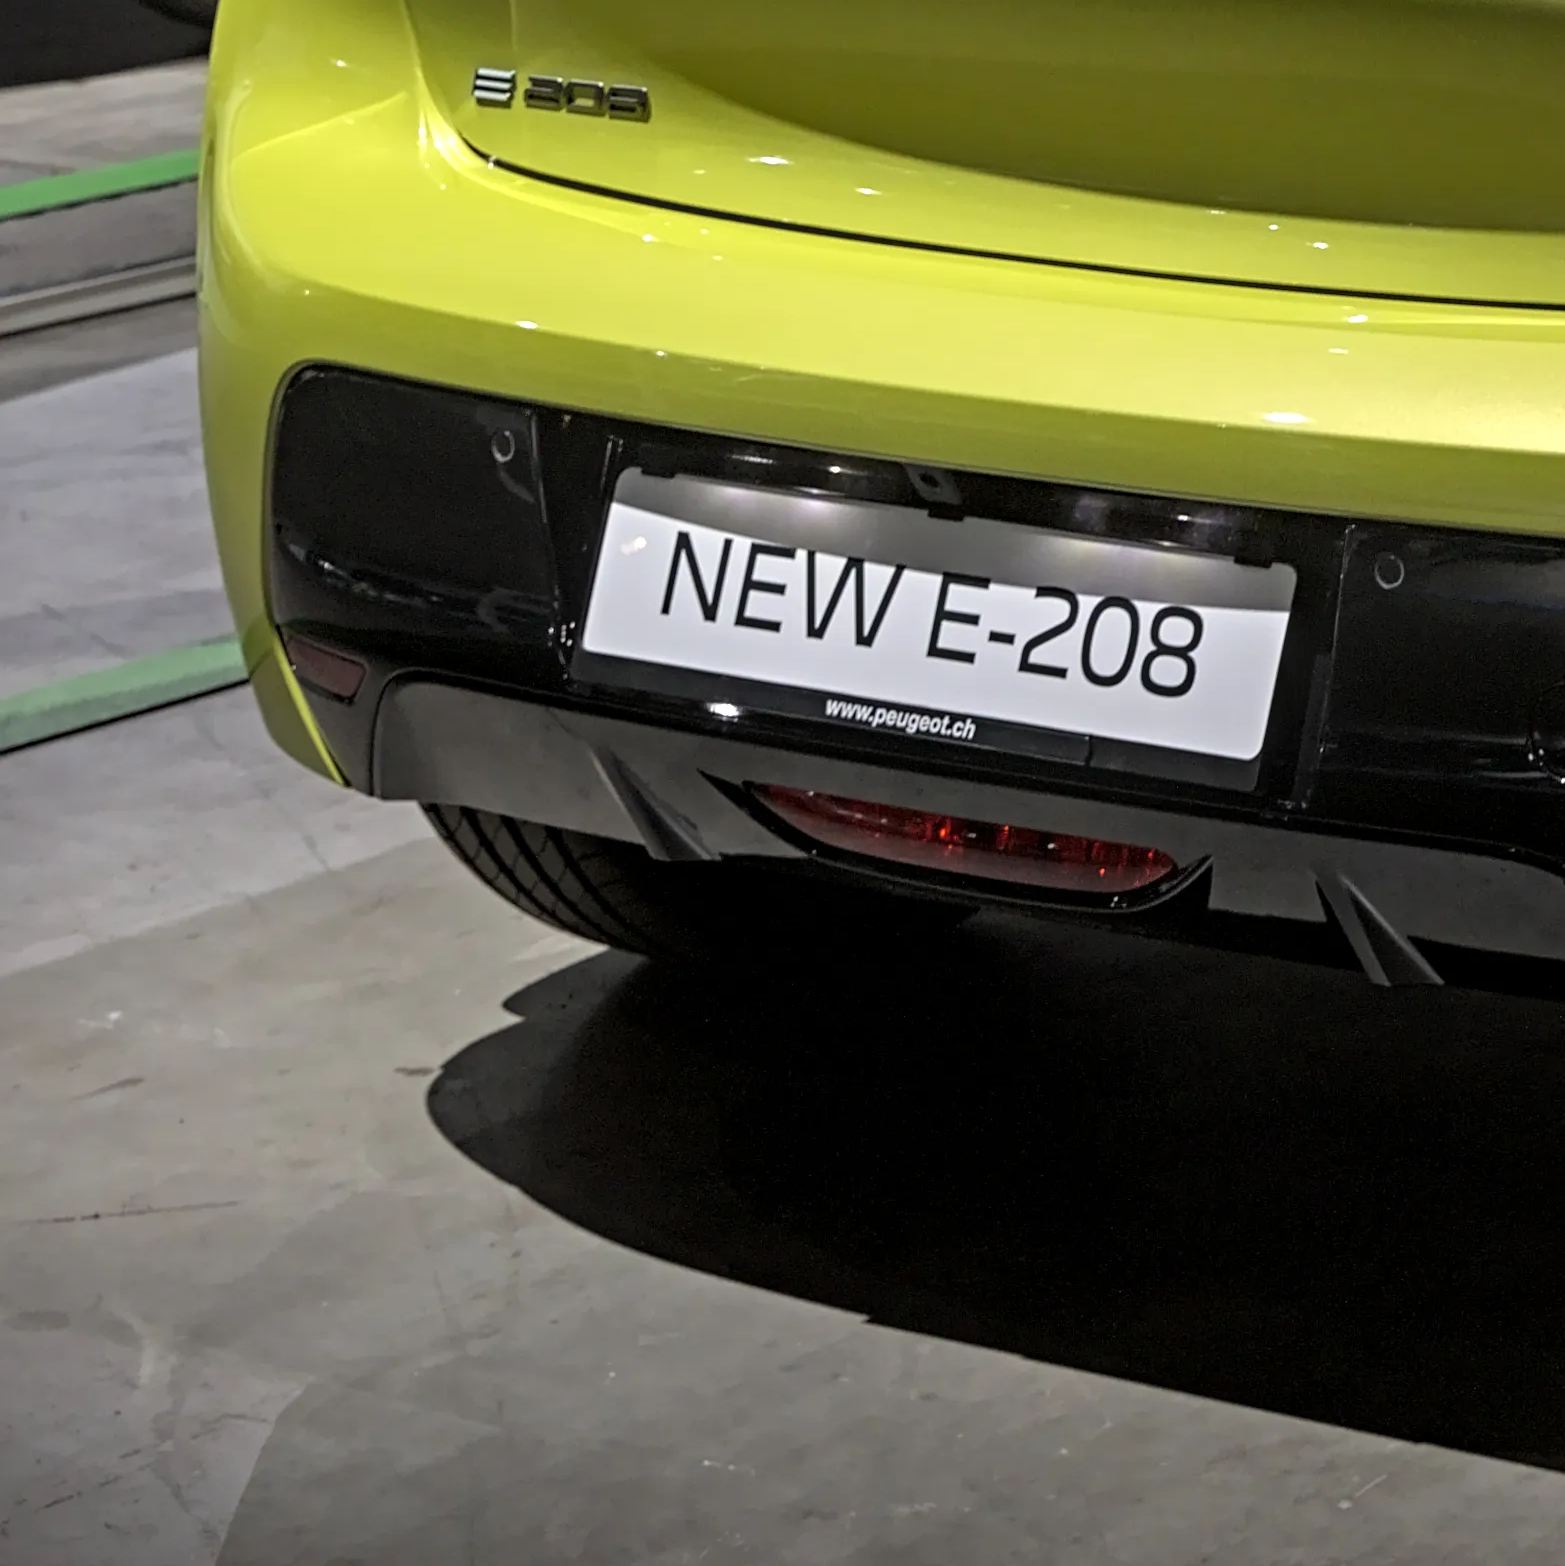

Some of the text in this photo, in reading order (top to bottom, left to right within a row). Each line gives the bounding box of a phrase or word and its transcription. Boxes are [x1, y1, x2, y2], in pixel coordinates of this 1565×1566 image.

[660, 530, 1204, 698] NEW E-208
[825, 698, 976, 740] www.peugeot.ch
